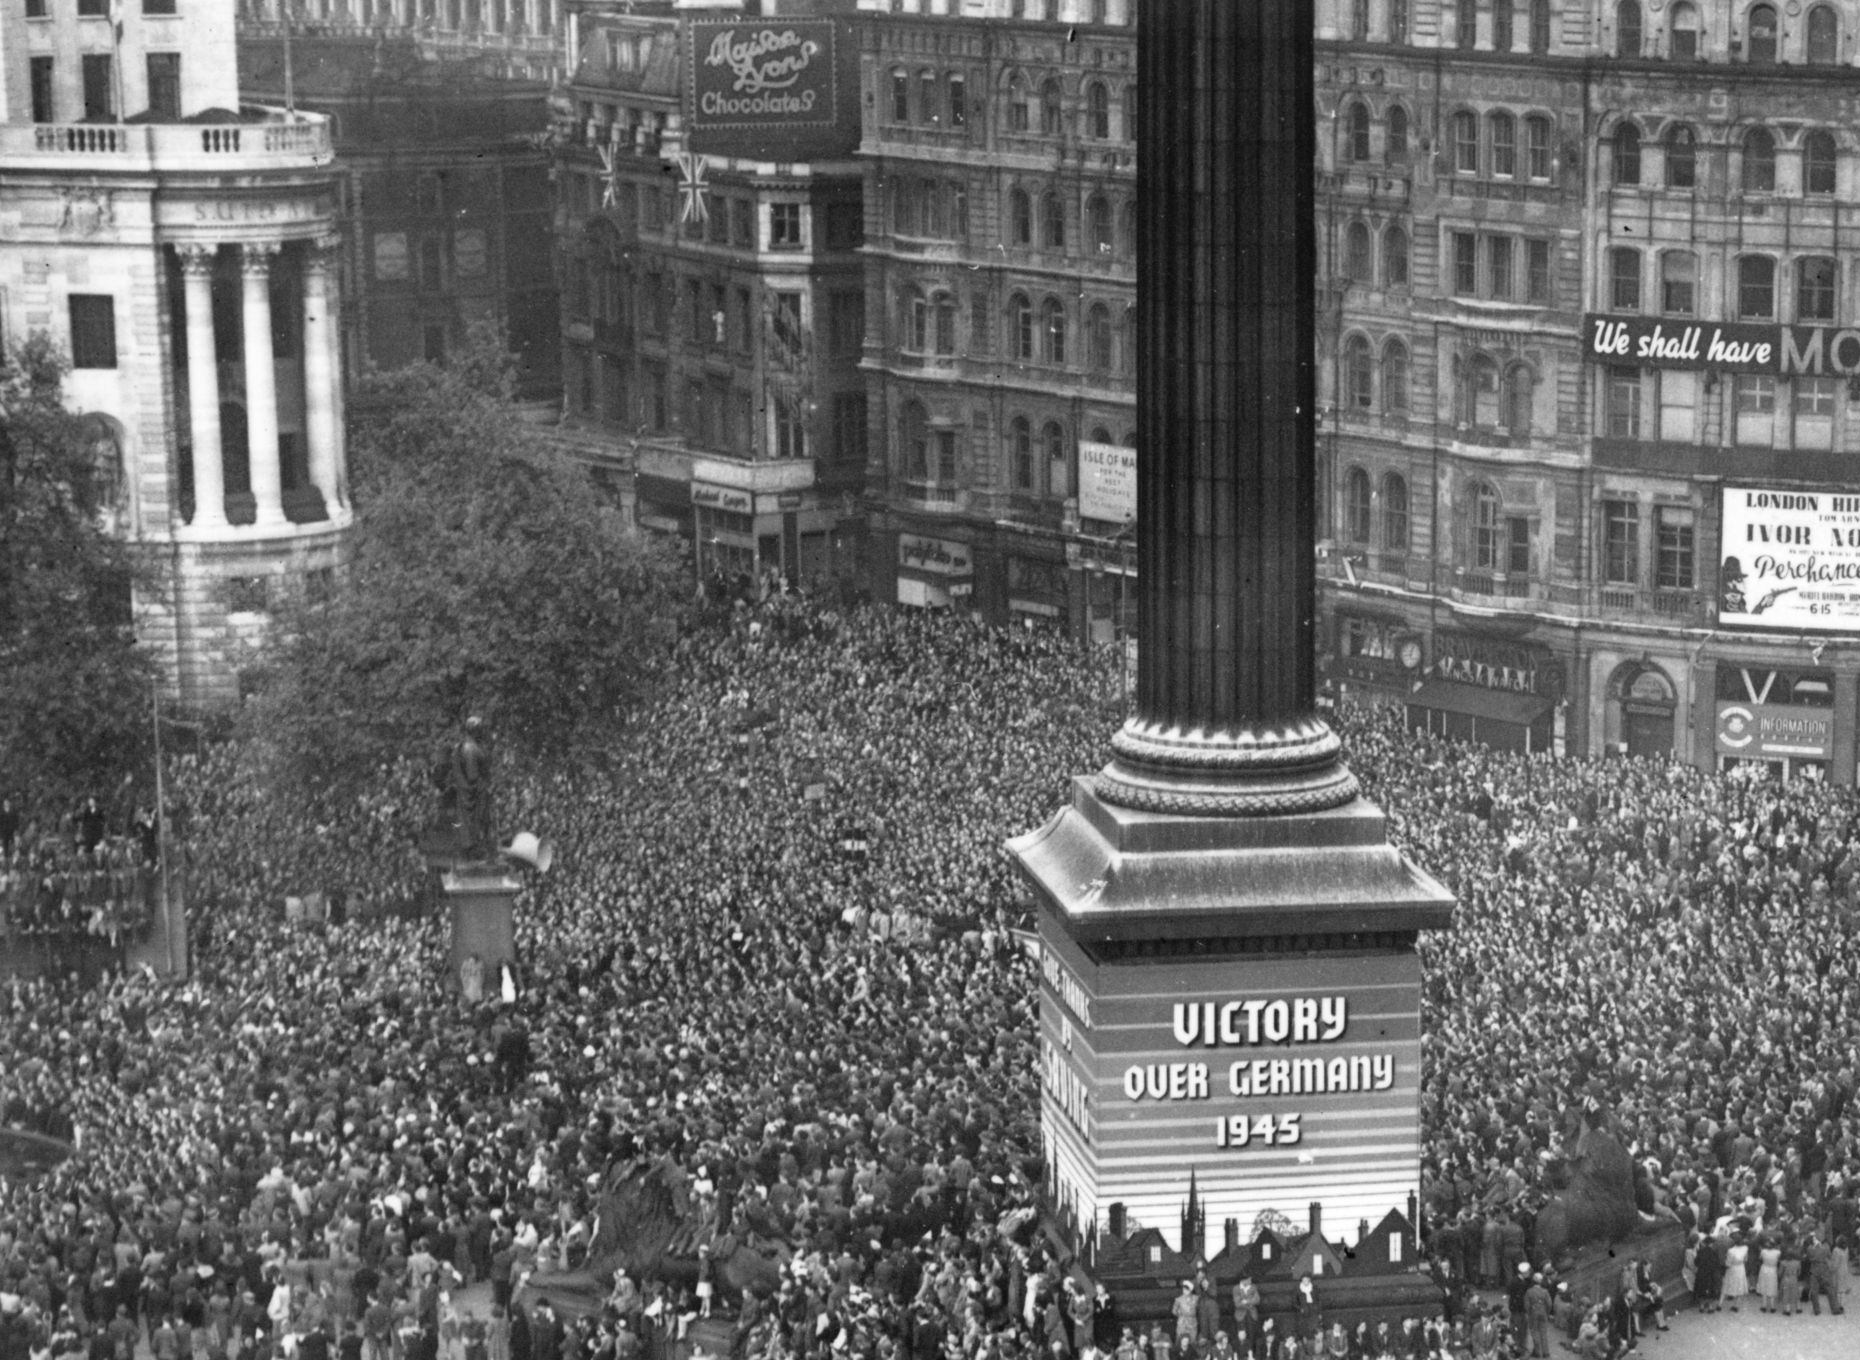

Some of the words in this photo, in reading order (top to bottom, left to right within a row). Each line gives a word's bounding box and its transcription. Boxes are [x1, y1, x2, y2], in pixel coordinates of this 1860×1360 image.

[704, 30, 801, 67] Maison
[733, 41, 818, 94] Lyons
[701, 89, 816, 115] Chocolates
[1593, 320, 1630, 355] We
[1637, 324, 1701, 359] shall
[1707, 328, 1772, 364] have
[1083, 450, 1105, 465] ISLE
[1107, 454, 1119, 466] OF
[1746, 492, 1818, 511] LONDON
[1819, 514, 1838, 523] TOM
[1746, 523, 1811, 545] IVOR
[1760, 717, 1826, 735] INFORMATION
[1172, 996, 1346, 1045] VICTORY
[1123, 1061, 1209, 1101] OVER
[1228, 1054, 1393, 1097] GERMANY
[1216, 1112, 1301, 1147] 1945
